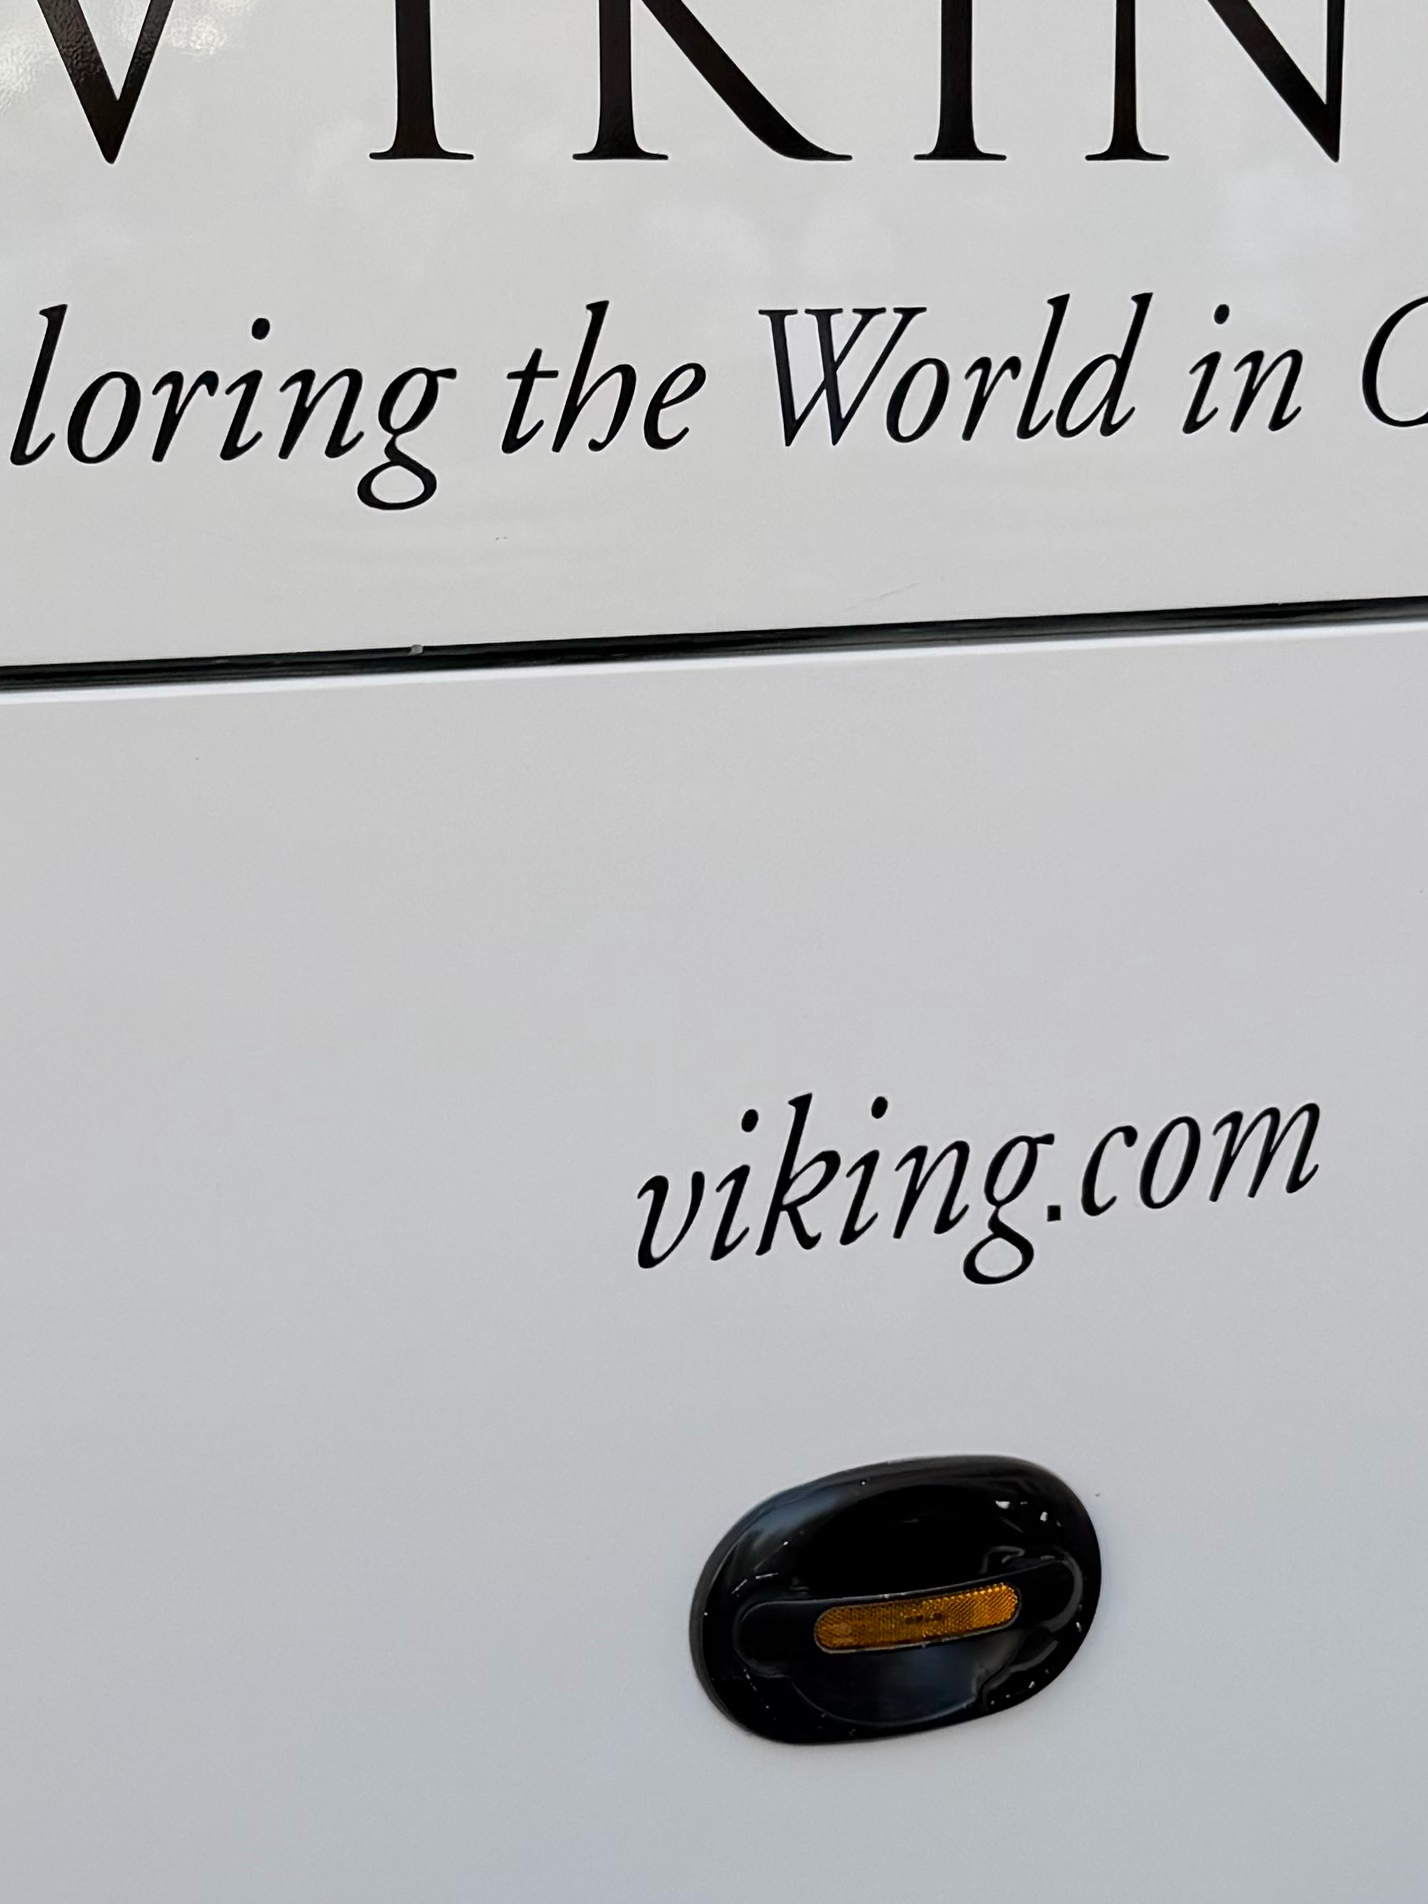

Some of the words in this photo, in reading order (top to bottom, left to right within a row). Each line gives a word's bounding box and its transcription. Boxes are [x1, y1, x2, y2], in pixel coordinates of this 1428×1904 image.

[499, 297, 709, 456] the
[756, 289, 1156, 449] World
[1180, 301, 1305, 437] in
[635, 1090, 1323, 1287] viking.com
